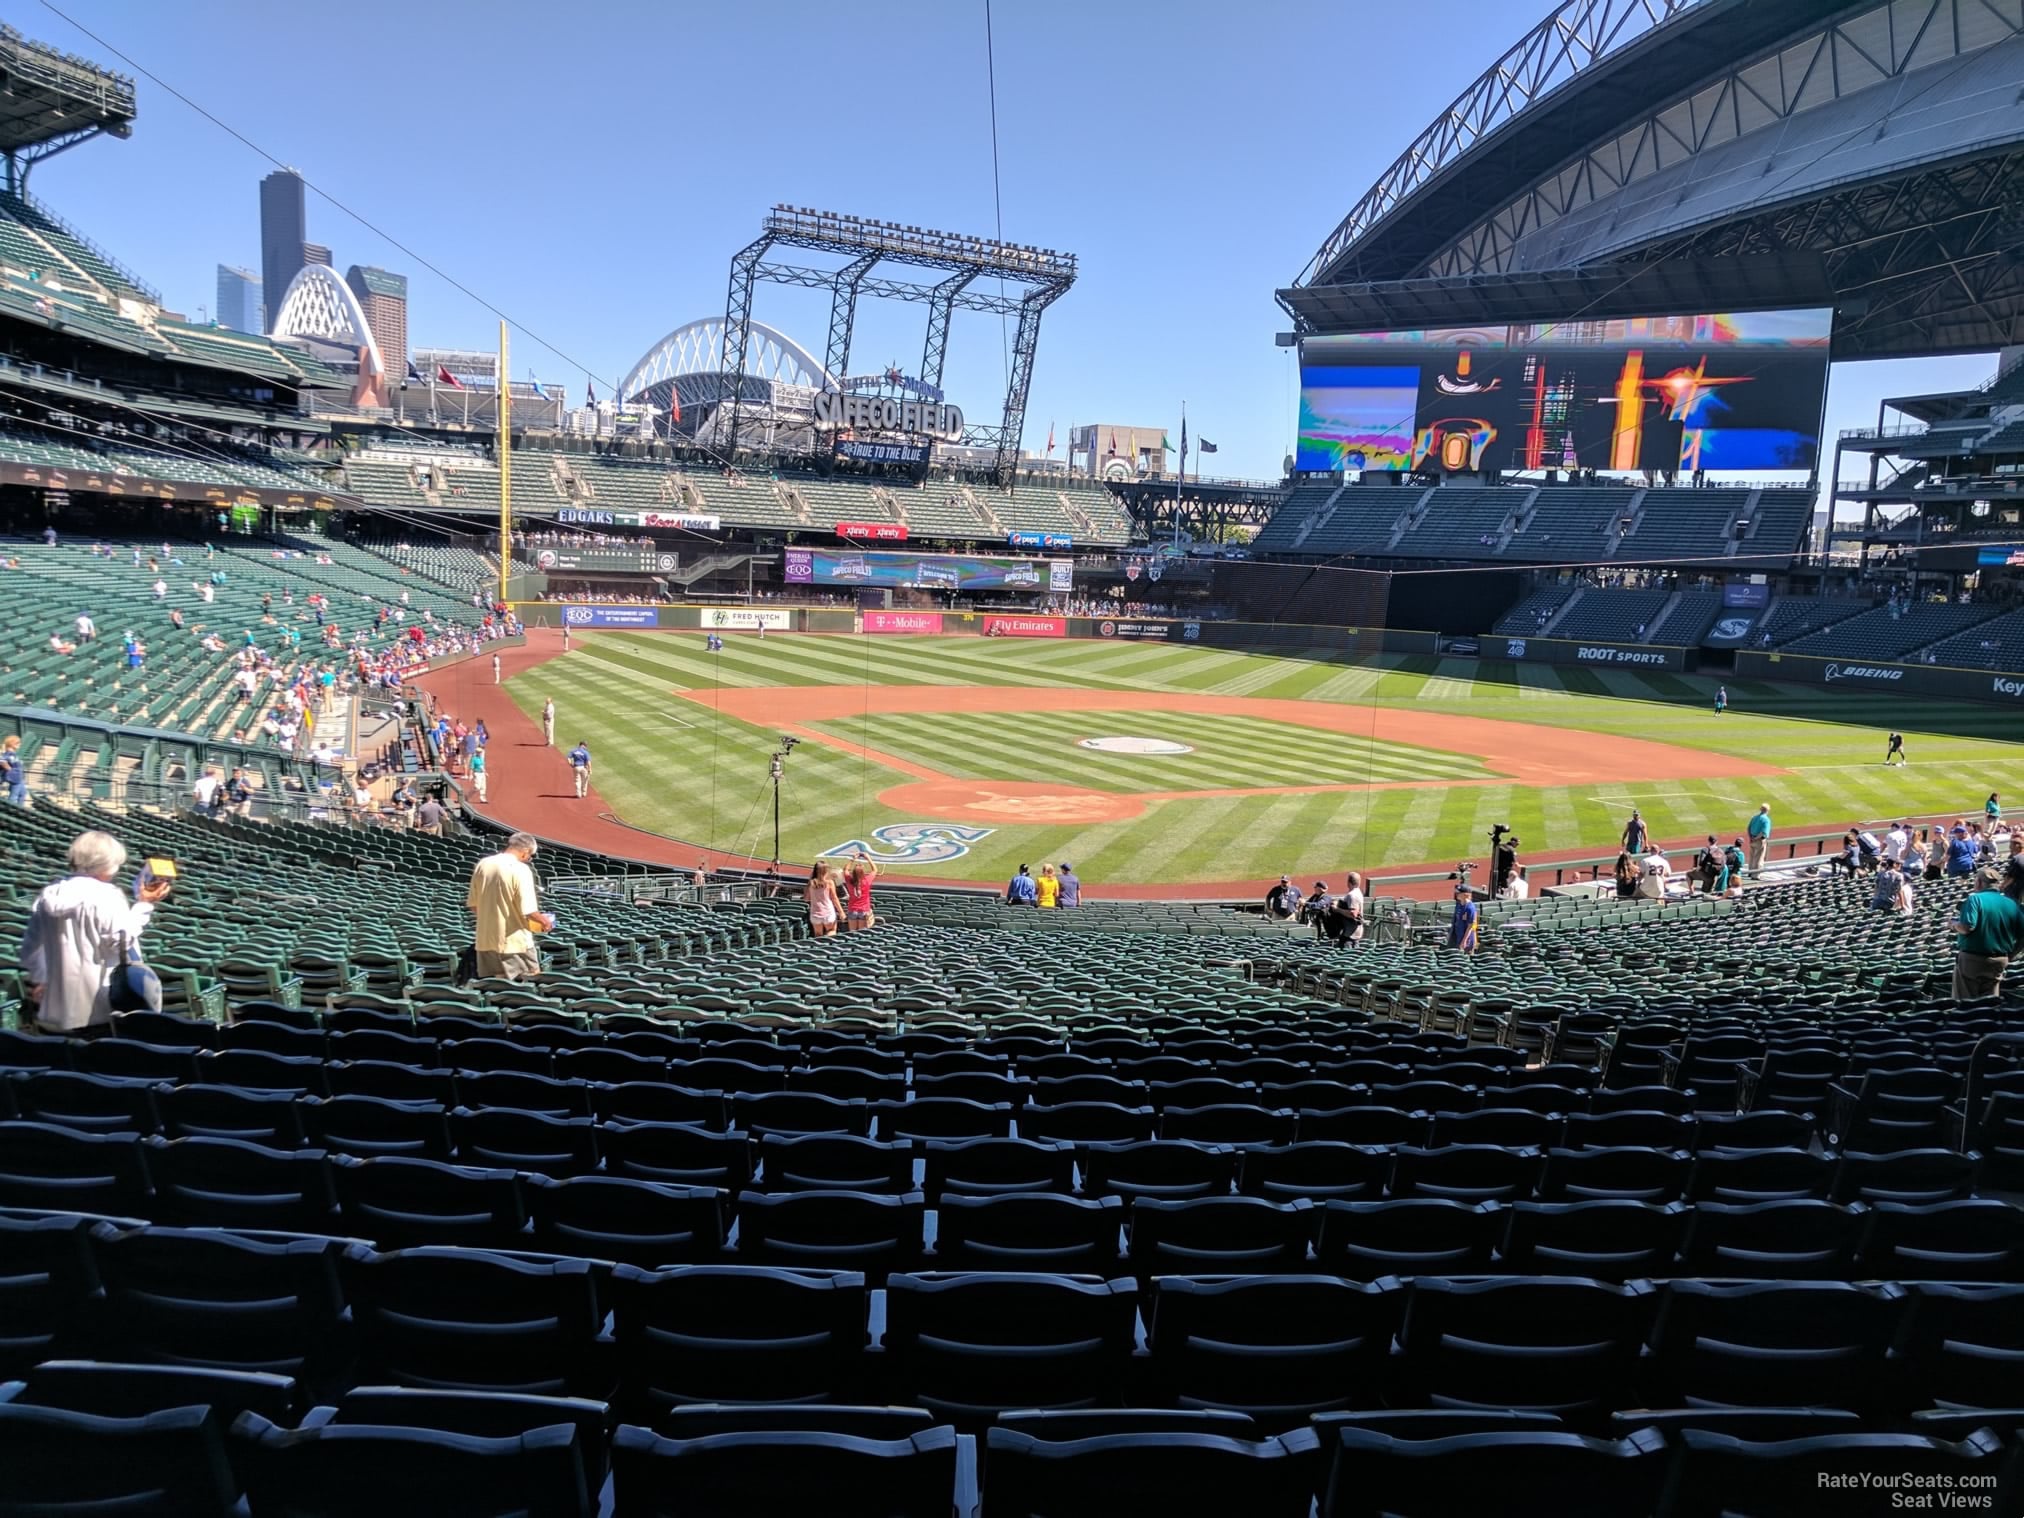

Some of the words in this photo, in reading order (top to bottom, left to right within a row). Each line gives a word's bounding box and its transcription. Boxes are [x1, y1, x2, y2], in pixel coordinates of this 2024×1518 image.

[815, 392, 898, 431] SAFECO
[901, 401, 964, 442] FIELD
[852, 442, 874, 458] TRUE
[874, 444, 884, 458] TO
[886, 446, 899, 459] THE
[901, 446, 922, 461] BLUE
[559, 510, 614, 525] EDGARS
[846, 527, 869, 536] xfinity
[876, 528, 899, 538] xfinity
[1022, 536, 1039, 546] pepsi
[1053, 537, 1071, 547] pepsi
[787, 565, 811, 576] EQC
[1053, 565, 1071, 573] BUILT
[1022, 572, 1040, 583] FIELD
[567, 609, 593, 621] EQC
[1013, 620, 1054, 631] Emirates
[1578, 647, 1616, 661] ROOT
[1616, 652, 1665, 664] SPORTS
[1843, 666, 1903, 680] BOEING
[1649, 865, 1664, 876] 23
